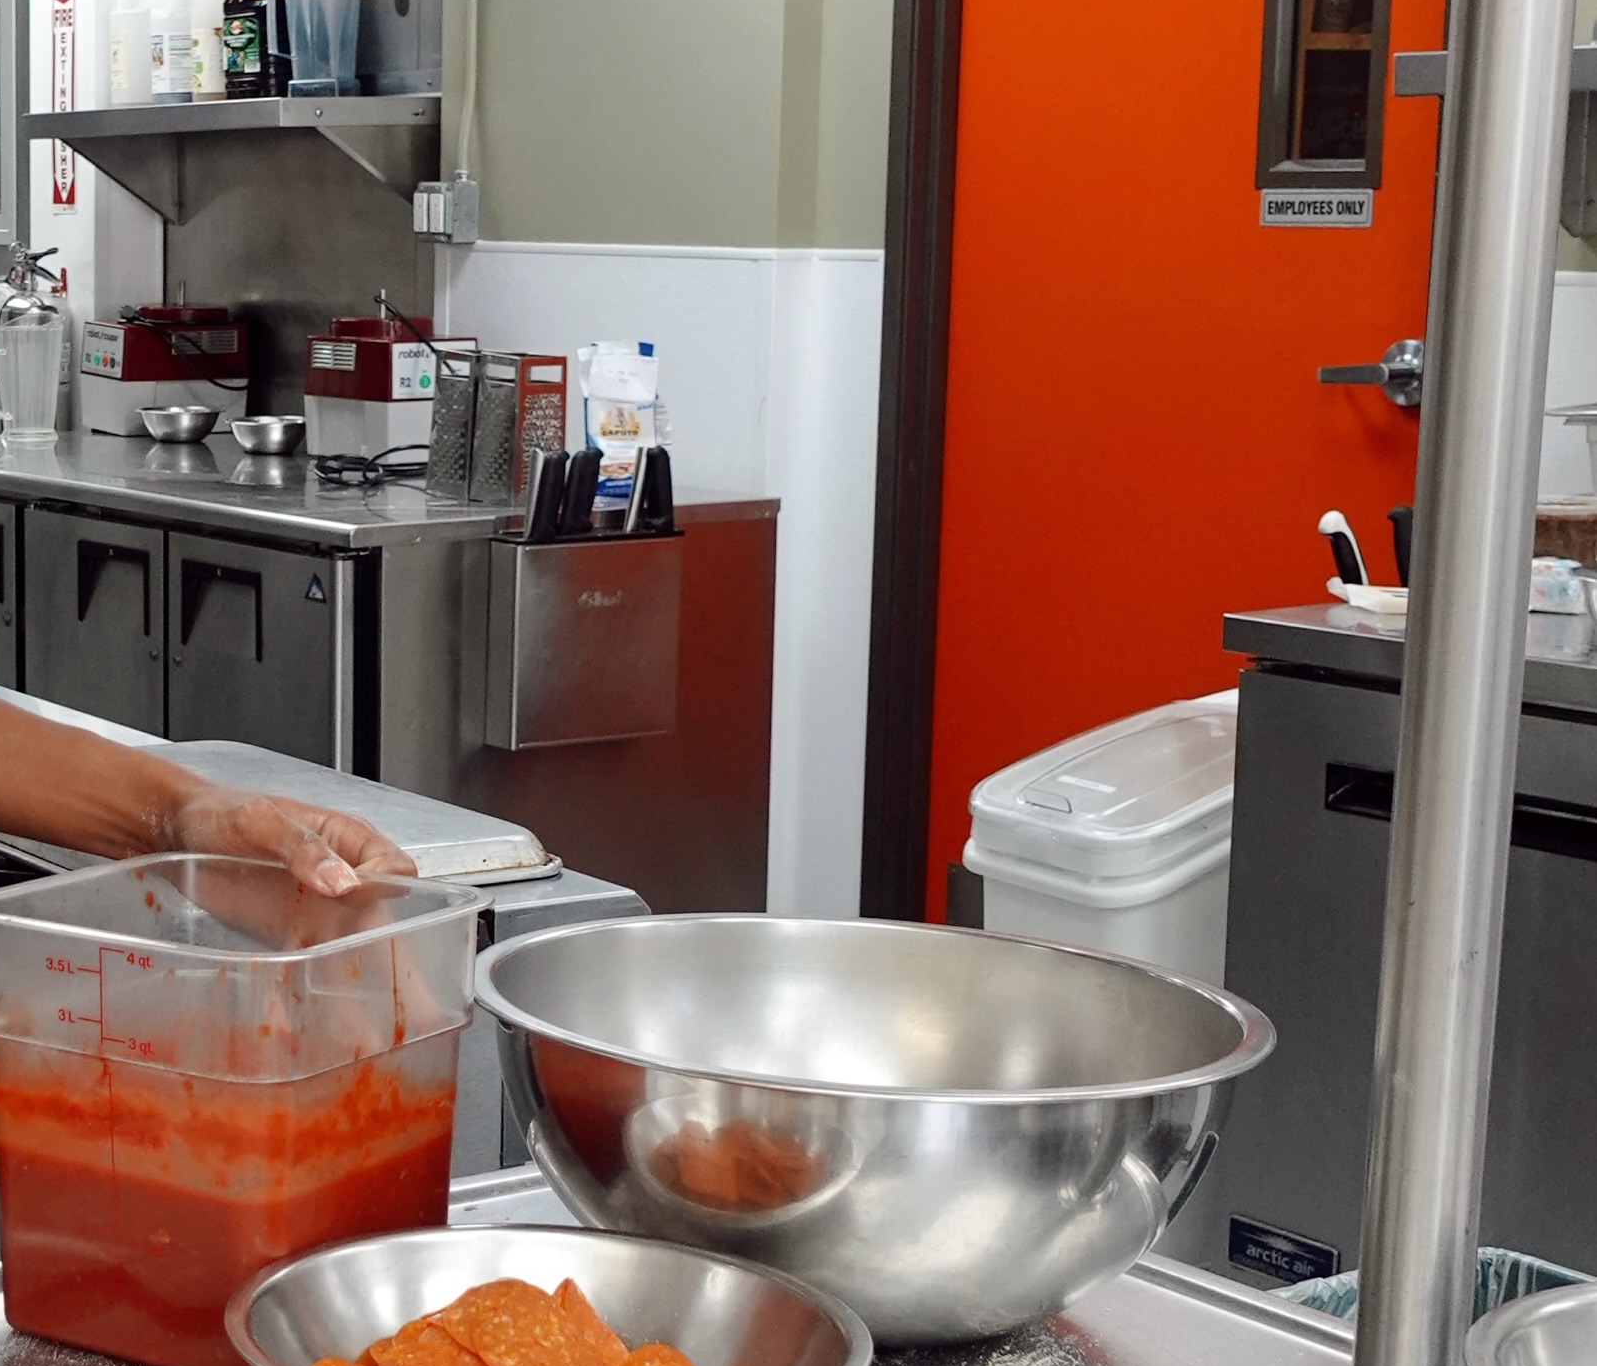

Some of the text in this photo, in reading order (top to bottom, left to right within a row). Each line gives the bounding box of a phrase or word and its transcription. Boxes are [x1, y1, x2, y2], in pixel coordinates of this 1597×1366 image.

[53, 7, 74, 28] FIRE
[1267, 200, 1365, 216] EMPLOYEES ONLY
[399, 377, 412, 388] R2
[45, 957, 75, 974] 3.5 L
[127, 953, 153, 969] 4 qt.
[58, 1008, 76, 1023] 3 L
[128, 1037, 137, 1050] 3
[1246, 1244, 1315, 1277] arctic air
